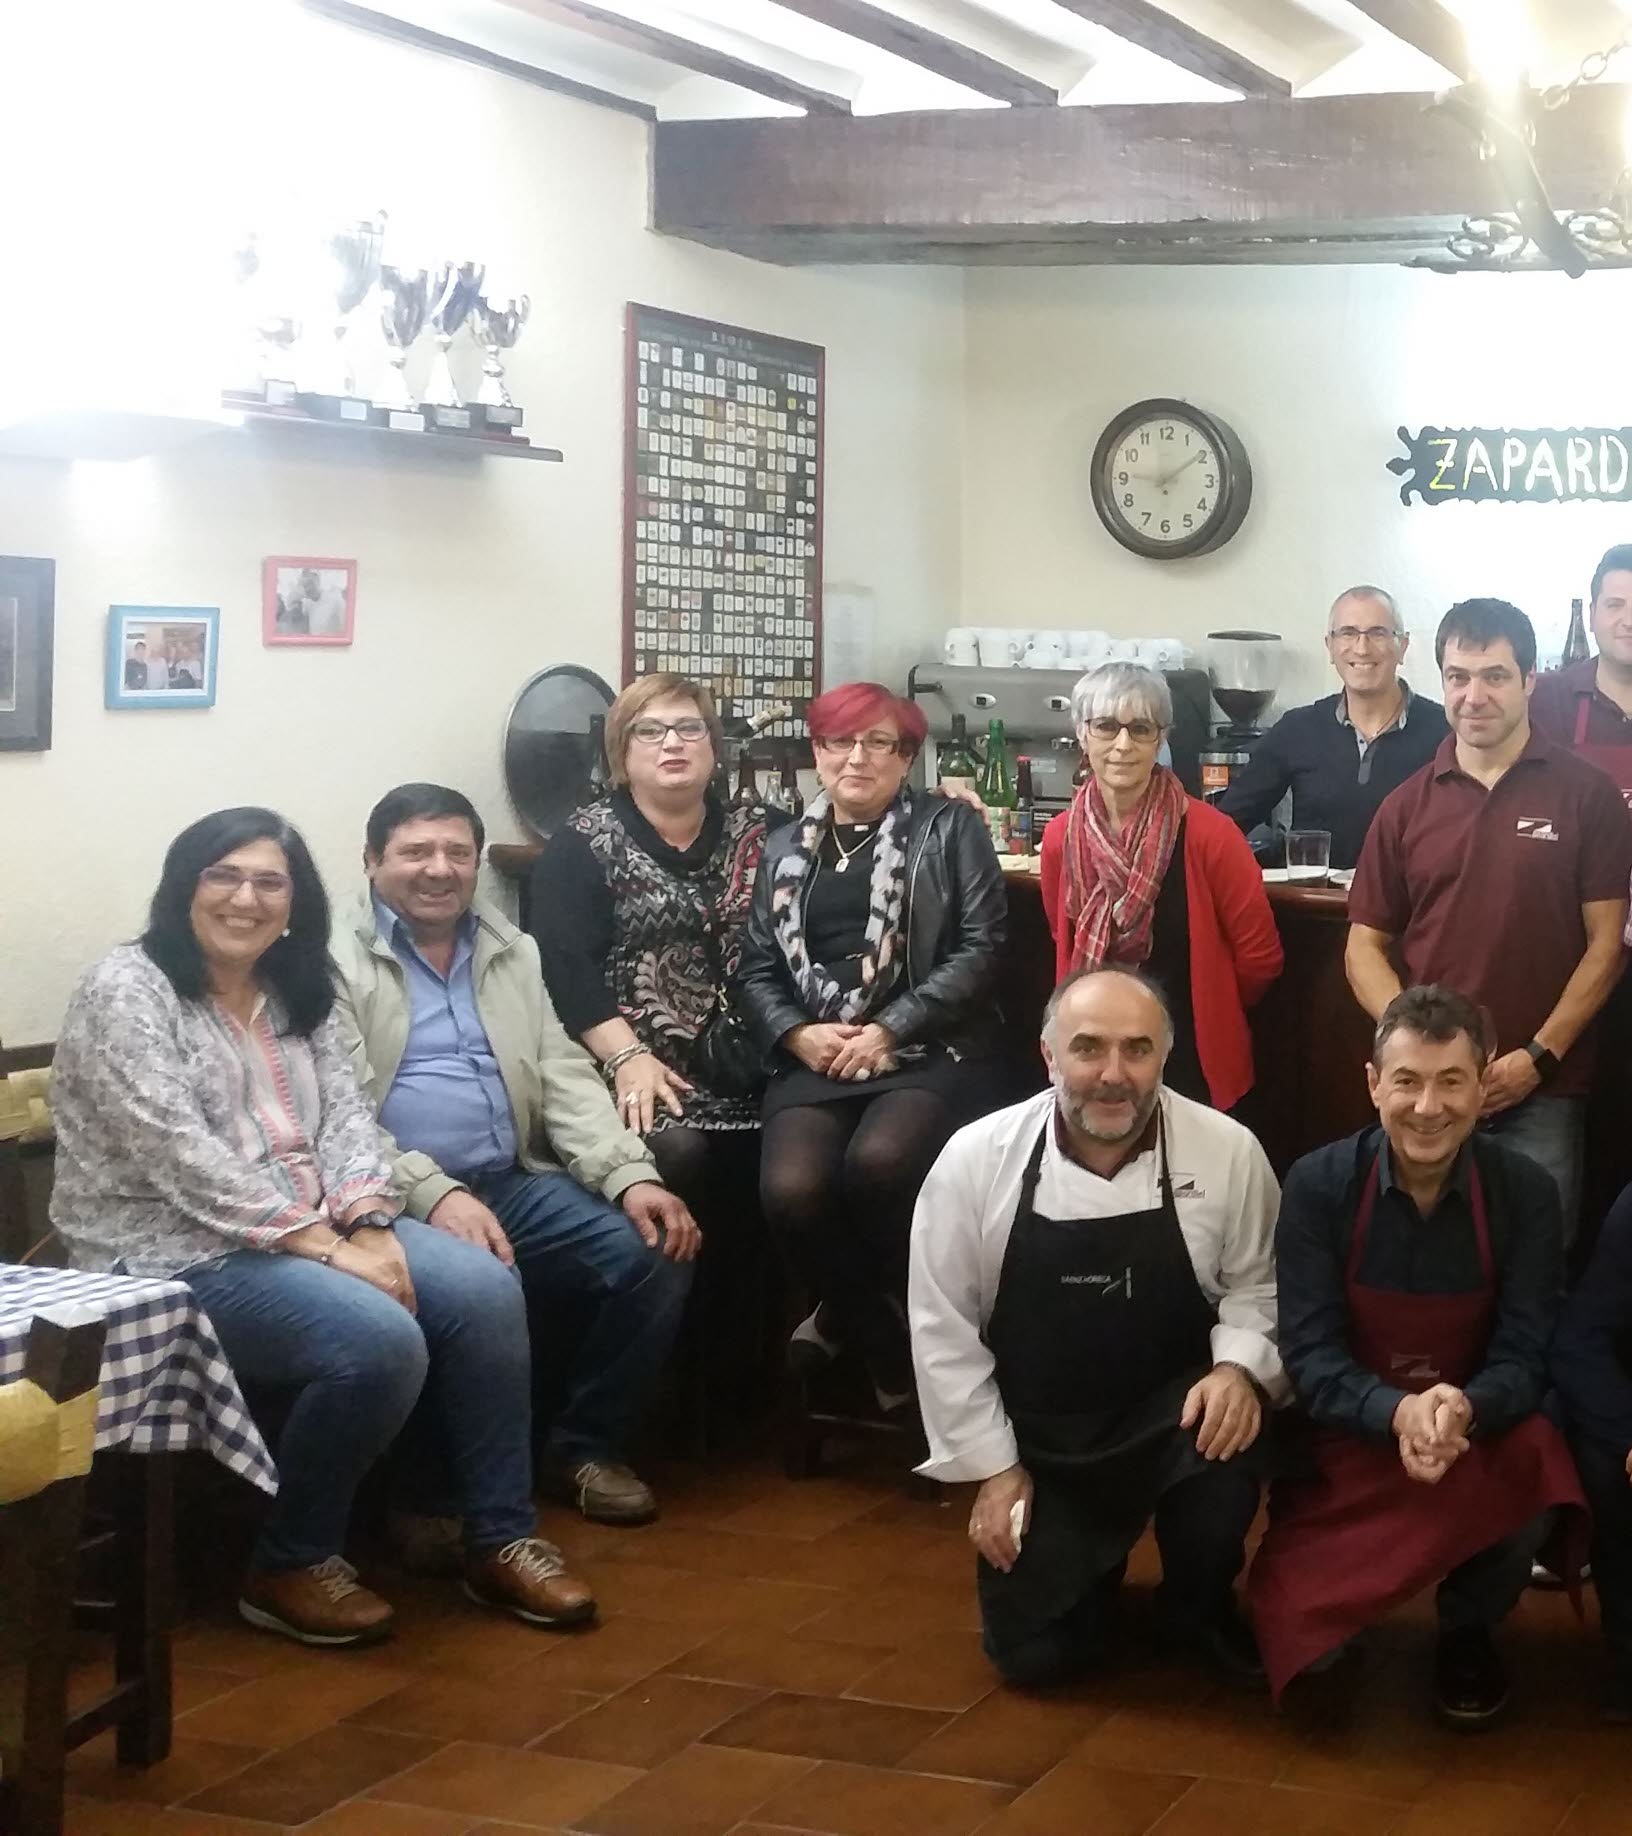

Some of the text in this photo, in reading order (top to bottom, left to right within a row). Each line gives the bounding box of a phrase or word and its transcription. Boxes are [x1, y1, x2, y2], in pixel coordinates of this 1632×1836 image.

[1140, 433, 1150, 445] 11
[1159, 426, 1175, 440] 12
[1125, 448, 1139, 462] 10
[1198, 450, 1208, 464] 2
[1118, 471, 1129, 485] 9
[1204, 474, 1215, 488] 3
[1123, 493, 1134, 508] 8
[1196, 498, 1208, 511] 4
[1141, 512, 1152, 526] 7
[1160, 519, 1171, 533] 6
[1182, 514, 1193, 528] 5
